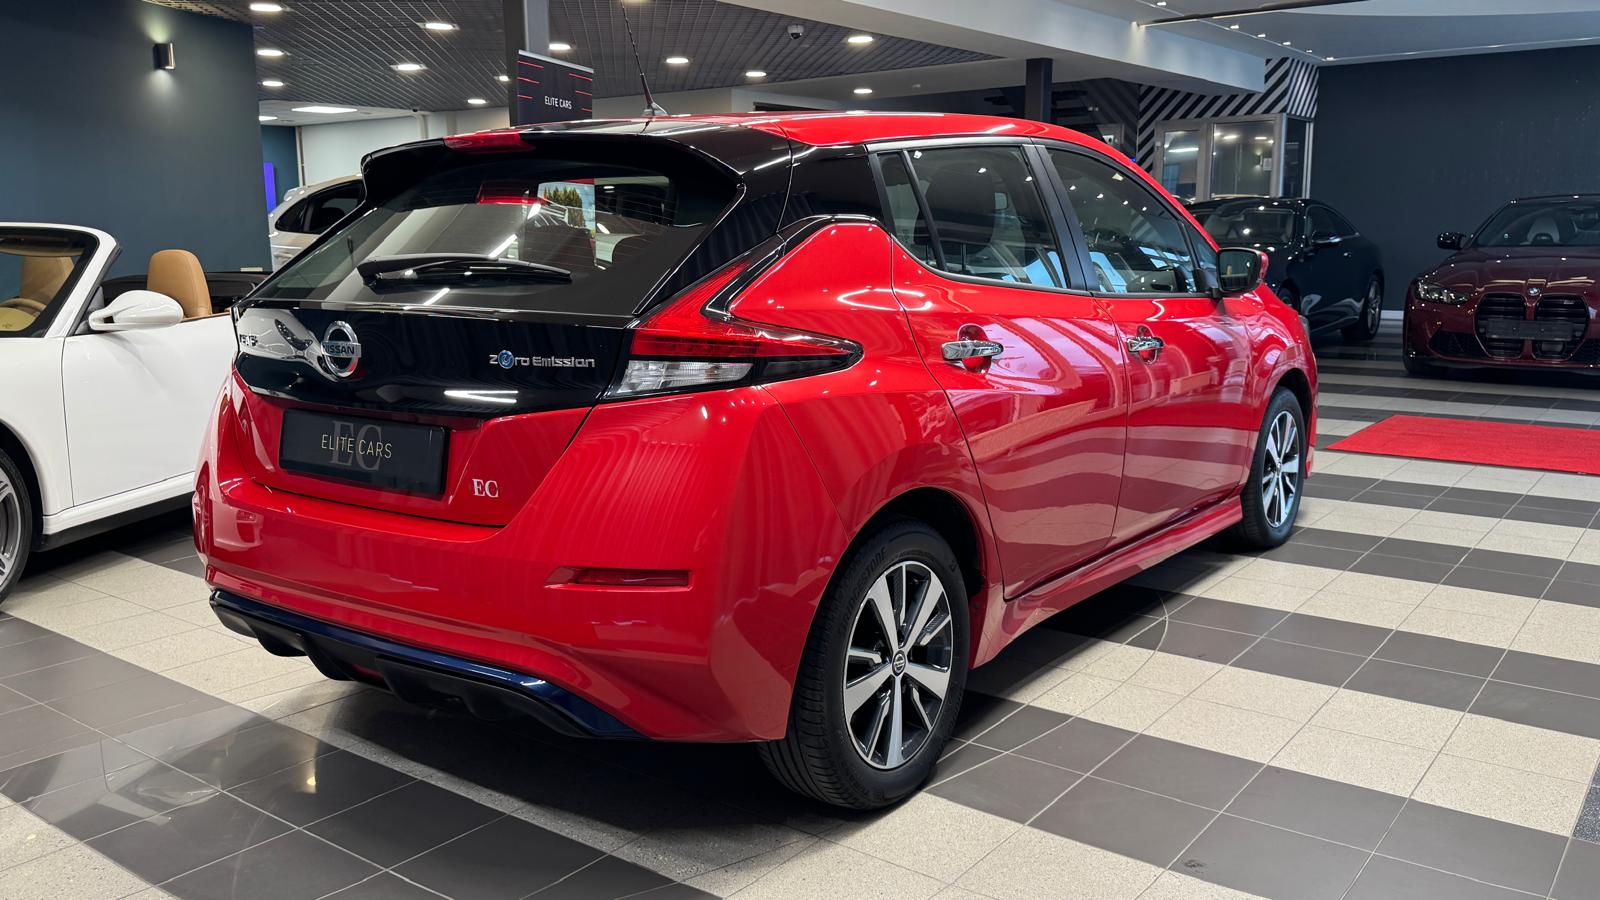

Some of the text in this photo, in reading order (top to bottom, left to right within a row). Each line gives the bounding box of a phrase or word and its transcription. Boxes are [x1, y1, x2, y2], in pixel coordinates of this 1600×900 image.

[544, 96, 572, 110] ELITE CARS
[322, 343, 355, 355] NISSAN
[532, 356, 596, 368] Emission
[321, 434, 393, 459] ELITE CARS
[472, 478, 499, 498] EC
